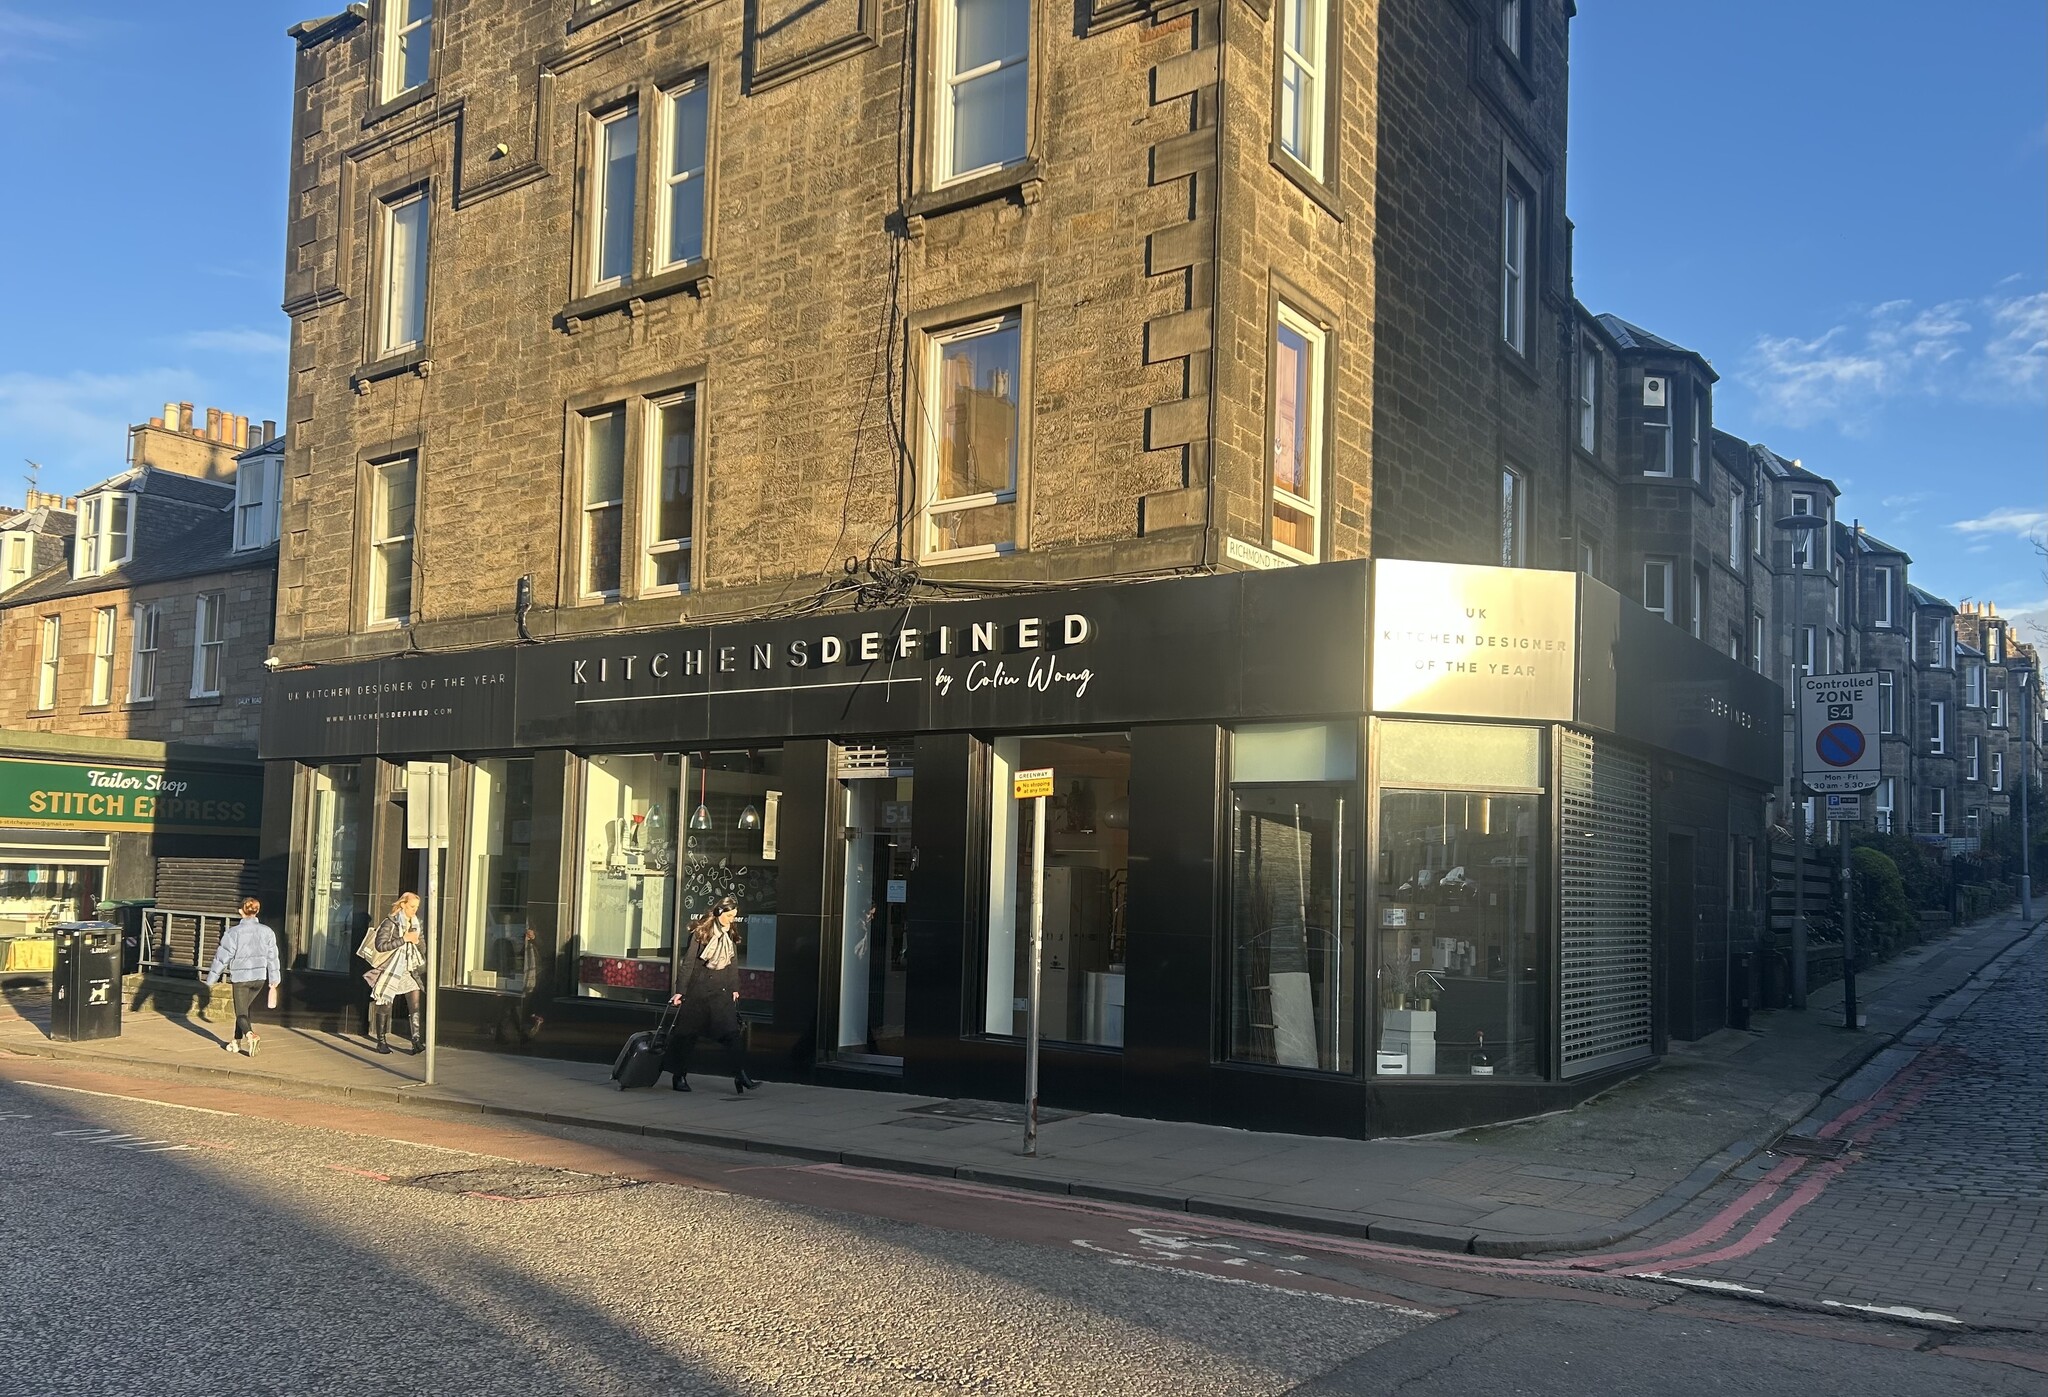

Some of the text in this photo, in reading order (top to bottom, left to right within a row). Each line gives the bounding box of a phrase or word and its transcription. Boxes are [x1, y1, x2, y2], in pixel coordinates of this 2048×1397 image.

[1229, 541, 1271, 568] RICHMOND
[1465, 608, 1487, 619] UK
[1383, 630, 1567, 652] KITCHEN DESIGNER
[935, 654, 1095, 698] by Colin Wong
[1415, 660, 1536, 677] OF THE YEAR
[288, 673, 506, 701] UK KITCHEN DESIGNER OF THE YEAR
[1806, 677, 1874, 690] Controlled
[1816, 690, 1864, 703] ZONE
[1830, 706, 1852, 719] S4
[87, 770, 188, 797] Tailor Shop
[1019, 771, 1048, 779] GREENWAY
[29, 790, 247, 822] STITCH EXPRESS
